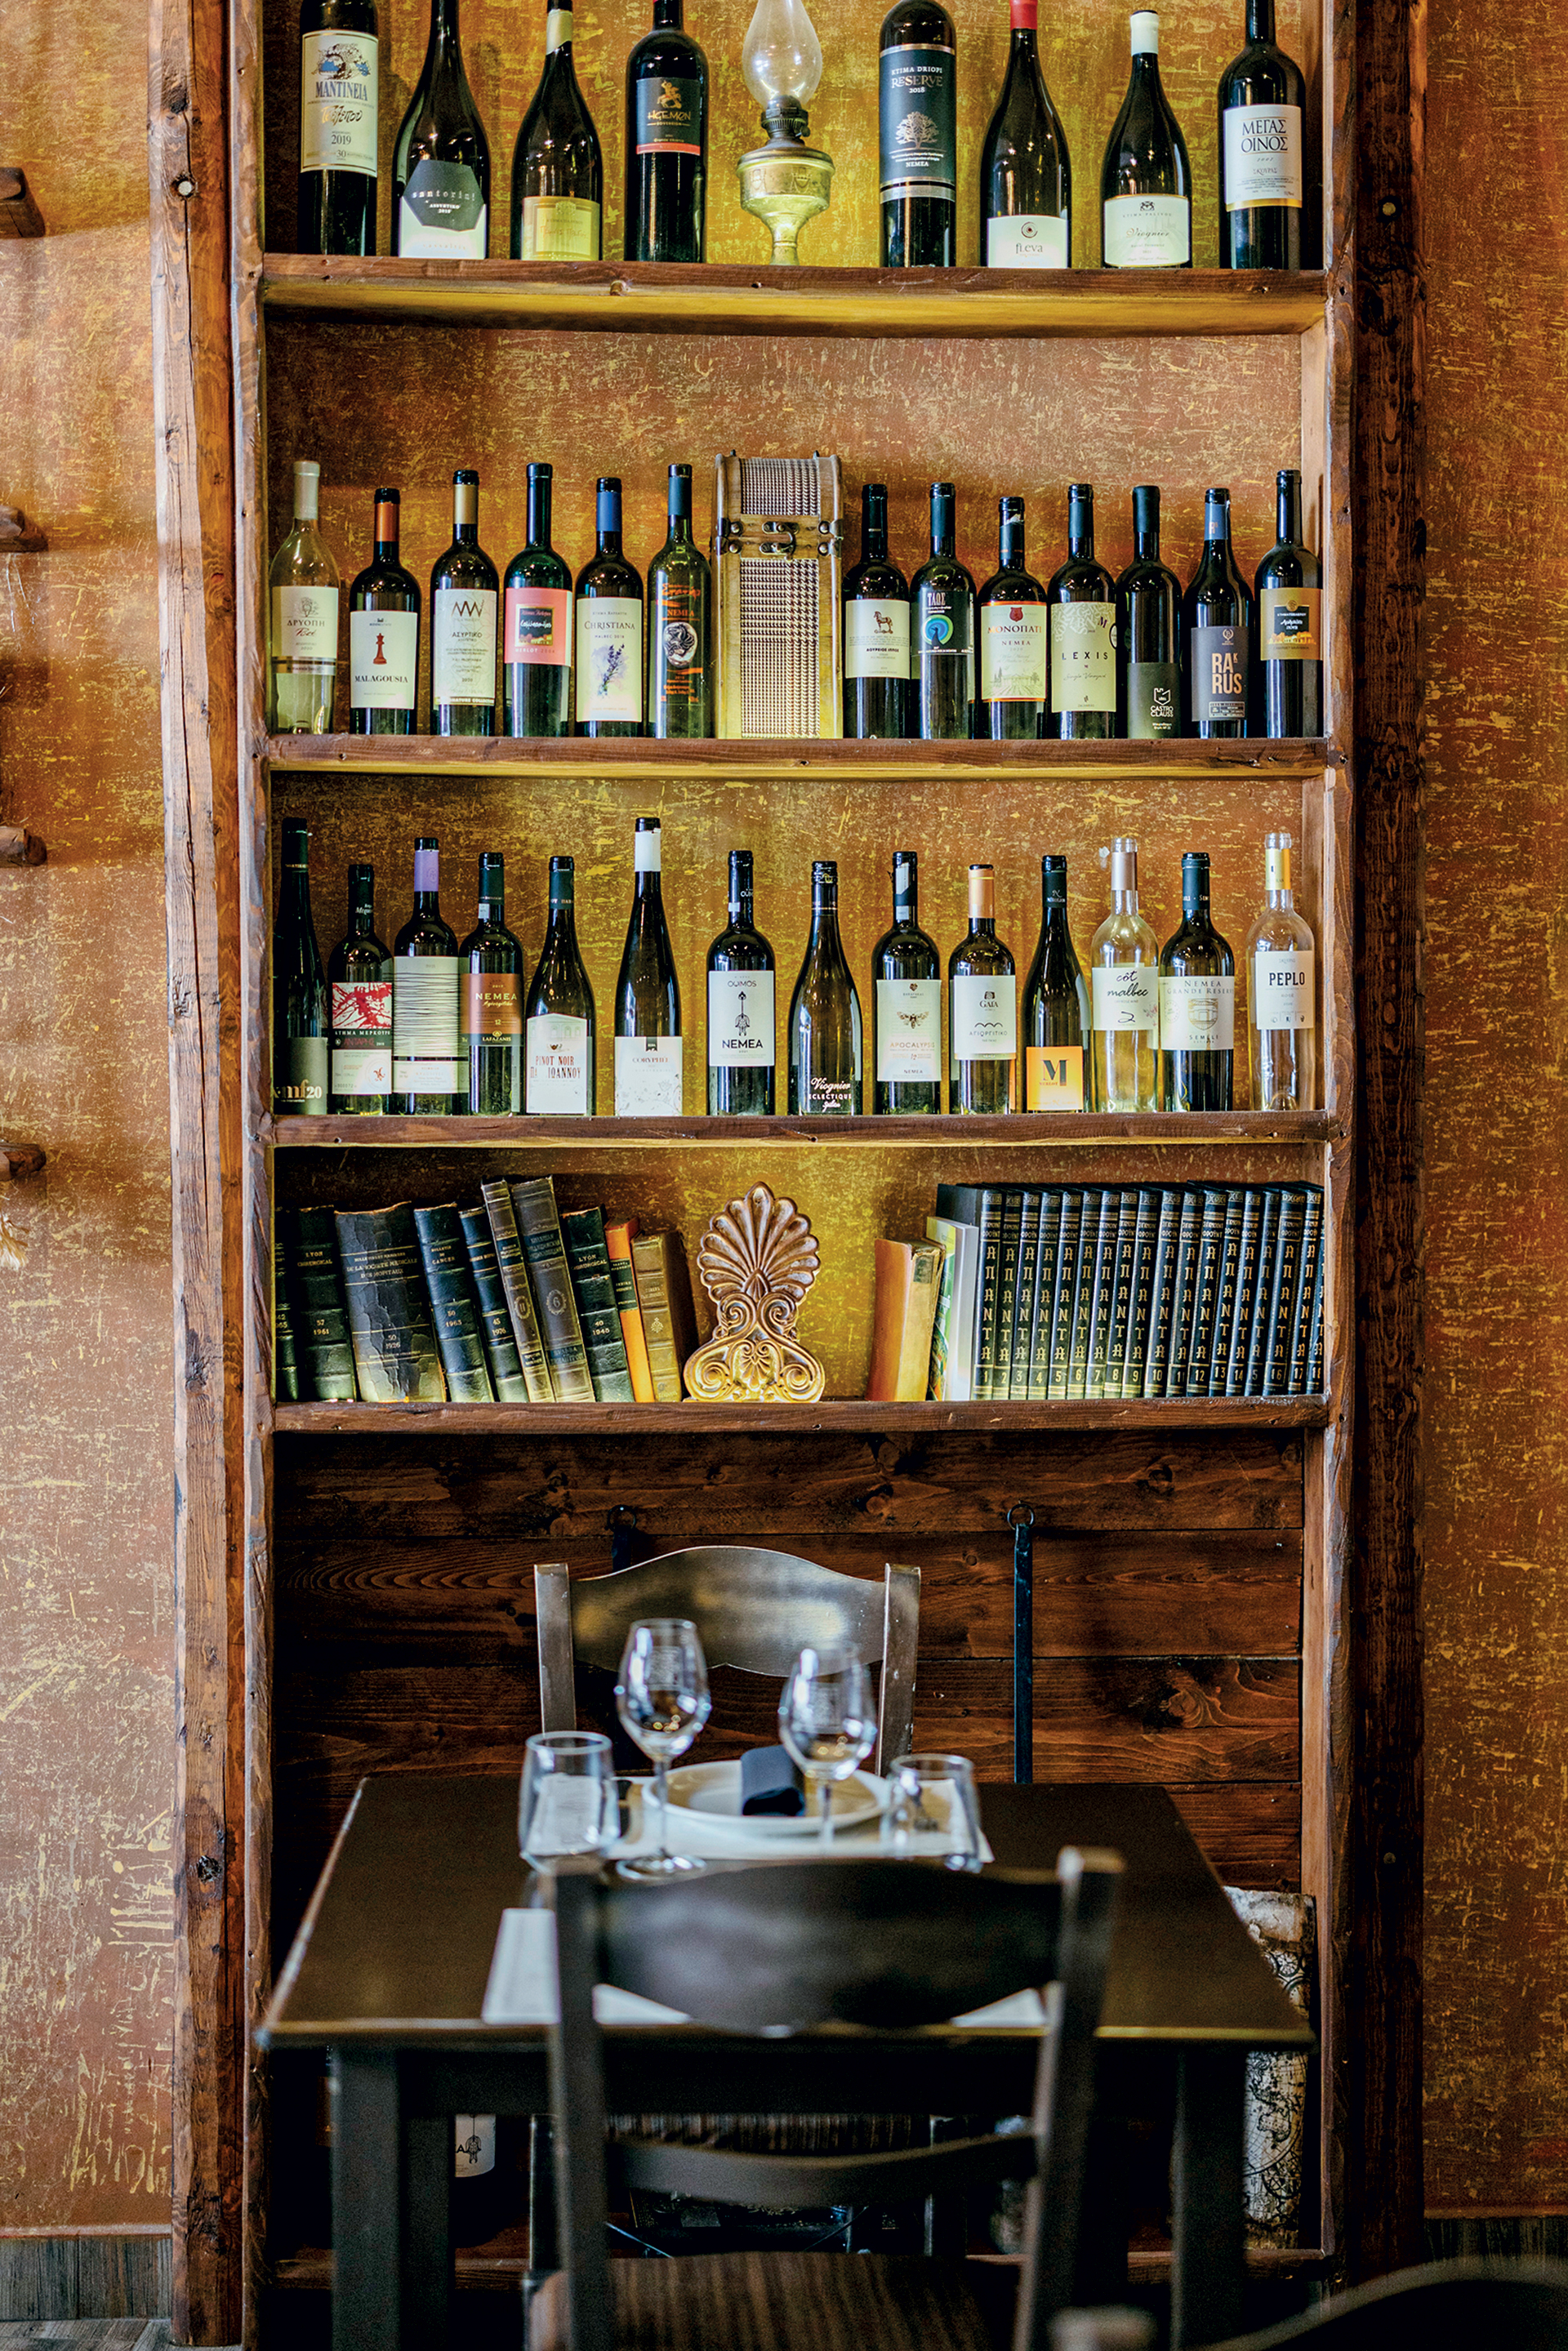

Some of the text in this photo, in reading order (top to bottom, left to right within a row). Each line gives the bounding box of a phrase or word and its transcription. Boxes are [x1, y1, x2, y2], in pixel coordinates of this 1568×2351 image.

[891, 67, 915, 75] KTIMA
[891, 74, 943, 89] RESERVE
[315, 81, 368, 101] MANTINEIA
[1242, 119, 1287, 136] ΜΕΓΑΣ
[331, 134, 351, 145] 2019
[1241, 136, 1288, 153] ΟΙΝΟΣ
[336, 149, 346, 158] 30
[412, 189, 475, 202] santorini
[1125, 227, 1170, 240] Viognier
[667, 608, 694, 617] NEMEA
[287, 619, 325, 627] ΔΡΥΟΠΗ
[584, 620, 635, 630] CHRISTIANA
[987, 625, 1042, 635] ΜΟΝΟΠΑΤΙ
[1062, 651, 1108, 661] LEXIS
[354, 675, 408, 683] MALAGOUSIA
[1212, 673, 1242, 694] RUS
[1116, 970, 1138, 982] côt
[1268, 971, 1306, 986] PEPLO
[475, 992, 518, 1000] NEMEA
[1107, 982, 1149, 997] malbec
[979, 1000, 999, 1009] GAIA
[722, 1039, 764, 1049] NEMEA
[535, 1055, 575, 1066] PINOT NOIR
[1040, 1058, 1070, 1087] M
[810, 1077, 851, 1094] Viognier
[431, 1256, 456, 1265] CANCER
[578, 1254, 596, 1262] LYON
[553, 1297, 560, 1307] 6
[981, 1245, 996, 1360] ΑΠΑΝΤΑ
[999, 1247, 1015, 1362] ΑΠΑΝΤΑ
[1015, 1245, 1035, 1360] ΑΠΑΝΤΑ
[1036, 1247, 1054, 1361] ΑΠΑΝΤΑ
[1054, 1246, 1073, 1360] ΑΠΑΝΤΑ
[1075, 1245, 1093, 1359] ΑΠΑΝΤΑ
[1094, 1245, 1112, 1360] ΑΠΑΝΤΑ
[1112, 1244, 1132, 1358] ΑΠΑΝΤΑ
[1132, 1246, 1152, 1360] ΑΠΑΝΤΑ
[1155, 1245, 1174, 1358] ΑΠΑΝΤΑ
[1177, 1246, 1195, 1360] ΑΠΑΝΤΑ
[1196, 1246, 1216, 1359] ΑΠΑΝΤΑ
[1217, 1242, 1237, 1356] ΑΠΑΝΤΑ
[1236, 1246, 1254, 1360] ΑΠΑΝΤΑ
[1252, 1245, 1272, 1358] ΑΠΑΝΤΑ
[1274, 1245, 1294, 1358] ΑΠΑΝΤΑ
[1297, 1245, 1316, 1357] ΑΠΑΝΤΑ
[492, 1328, 506, 1336] 1976
[1001, 1371, 1006, 1383] 2
[1016, 1370, 1022, 1383] 3
[1036, 1371, 1042, 1384] 4
[1055, 1370, 1062, 1383] 5
[1075, 1369, 1081, 1382] 6
[1094, 1369, 1101, 1382] 7
[1112, 1368, 1119, 1381] 8
[1132, 1369, 1139, 1383] 9
[1152, 1369, 1163, 1382] 10
[1195, 1369, 1205, 1382] 12
[1214, 1365, 1225, 1378] 13
[1234, 1369, 1244, 1381] 14
[1271, 1368, 1282, 1380] 16
[1294, 1367, 1303, 1379] 17
